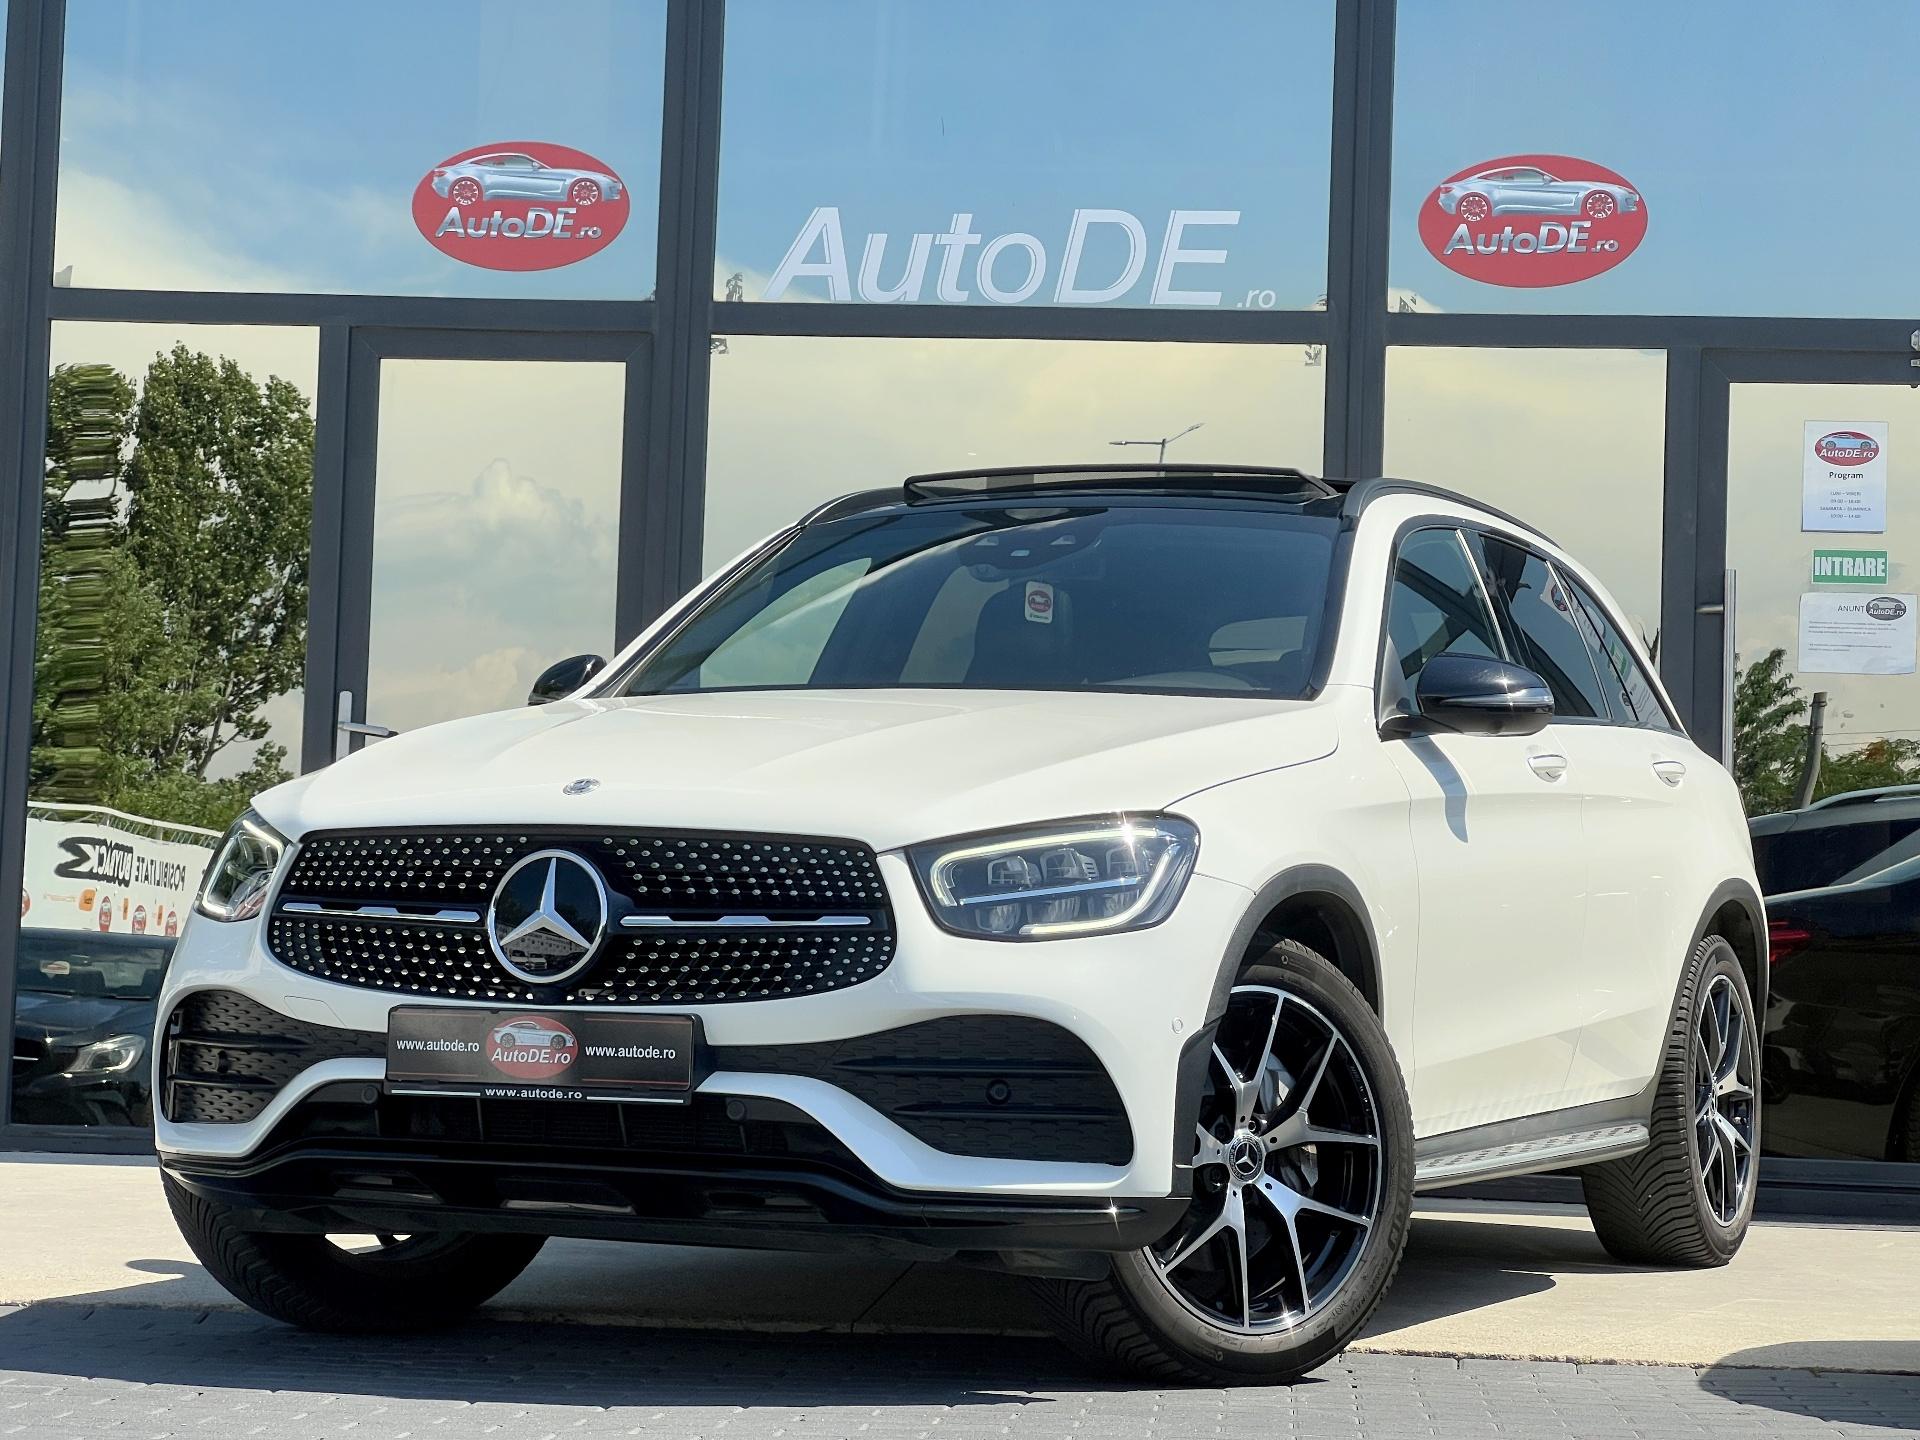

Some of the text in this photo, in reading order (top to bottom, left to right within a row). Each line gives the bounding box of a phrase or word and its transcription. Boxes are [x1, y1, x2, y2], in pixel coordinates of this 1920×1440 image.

[435, 207, 577, 238] AutoDE
[1443, 221, 1591, 255] AutoDE
[760, 207, 1241, 306] AutoDE
[1819, 448, 1875, 459] AutoDE.ro
[1829, 471, 1864, 481] Program
[1814, 556, 1886, 577] INTRARE
[396, 1038, 480, 1053] www.autode.ro
[585, 1043, 676, 1060] www.autode.ro
[491, 1048, 571, 1065] AutoDE.ro
[485, 1086, 583, 1100] www.autode.ro
